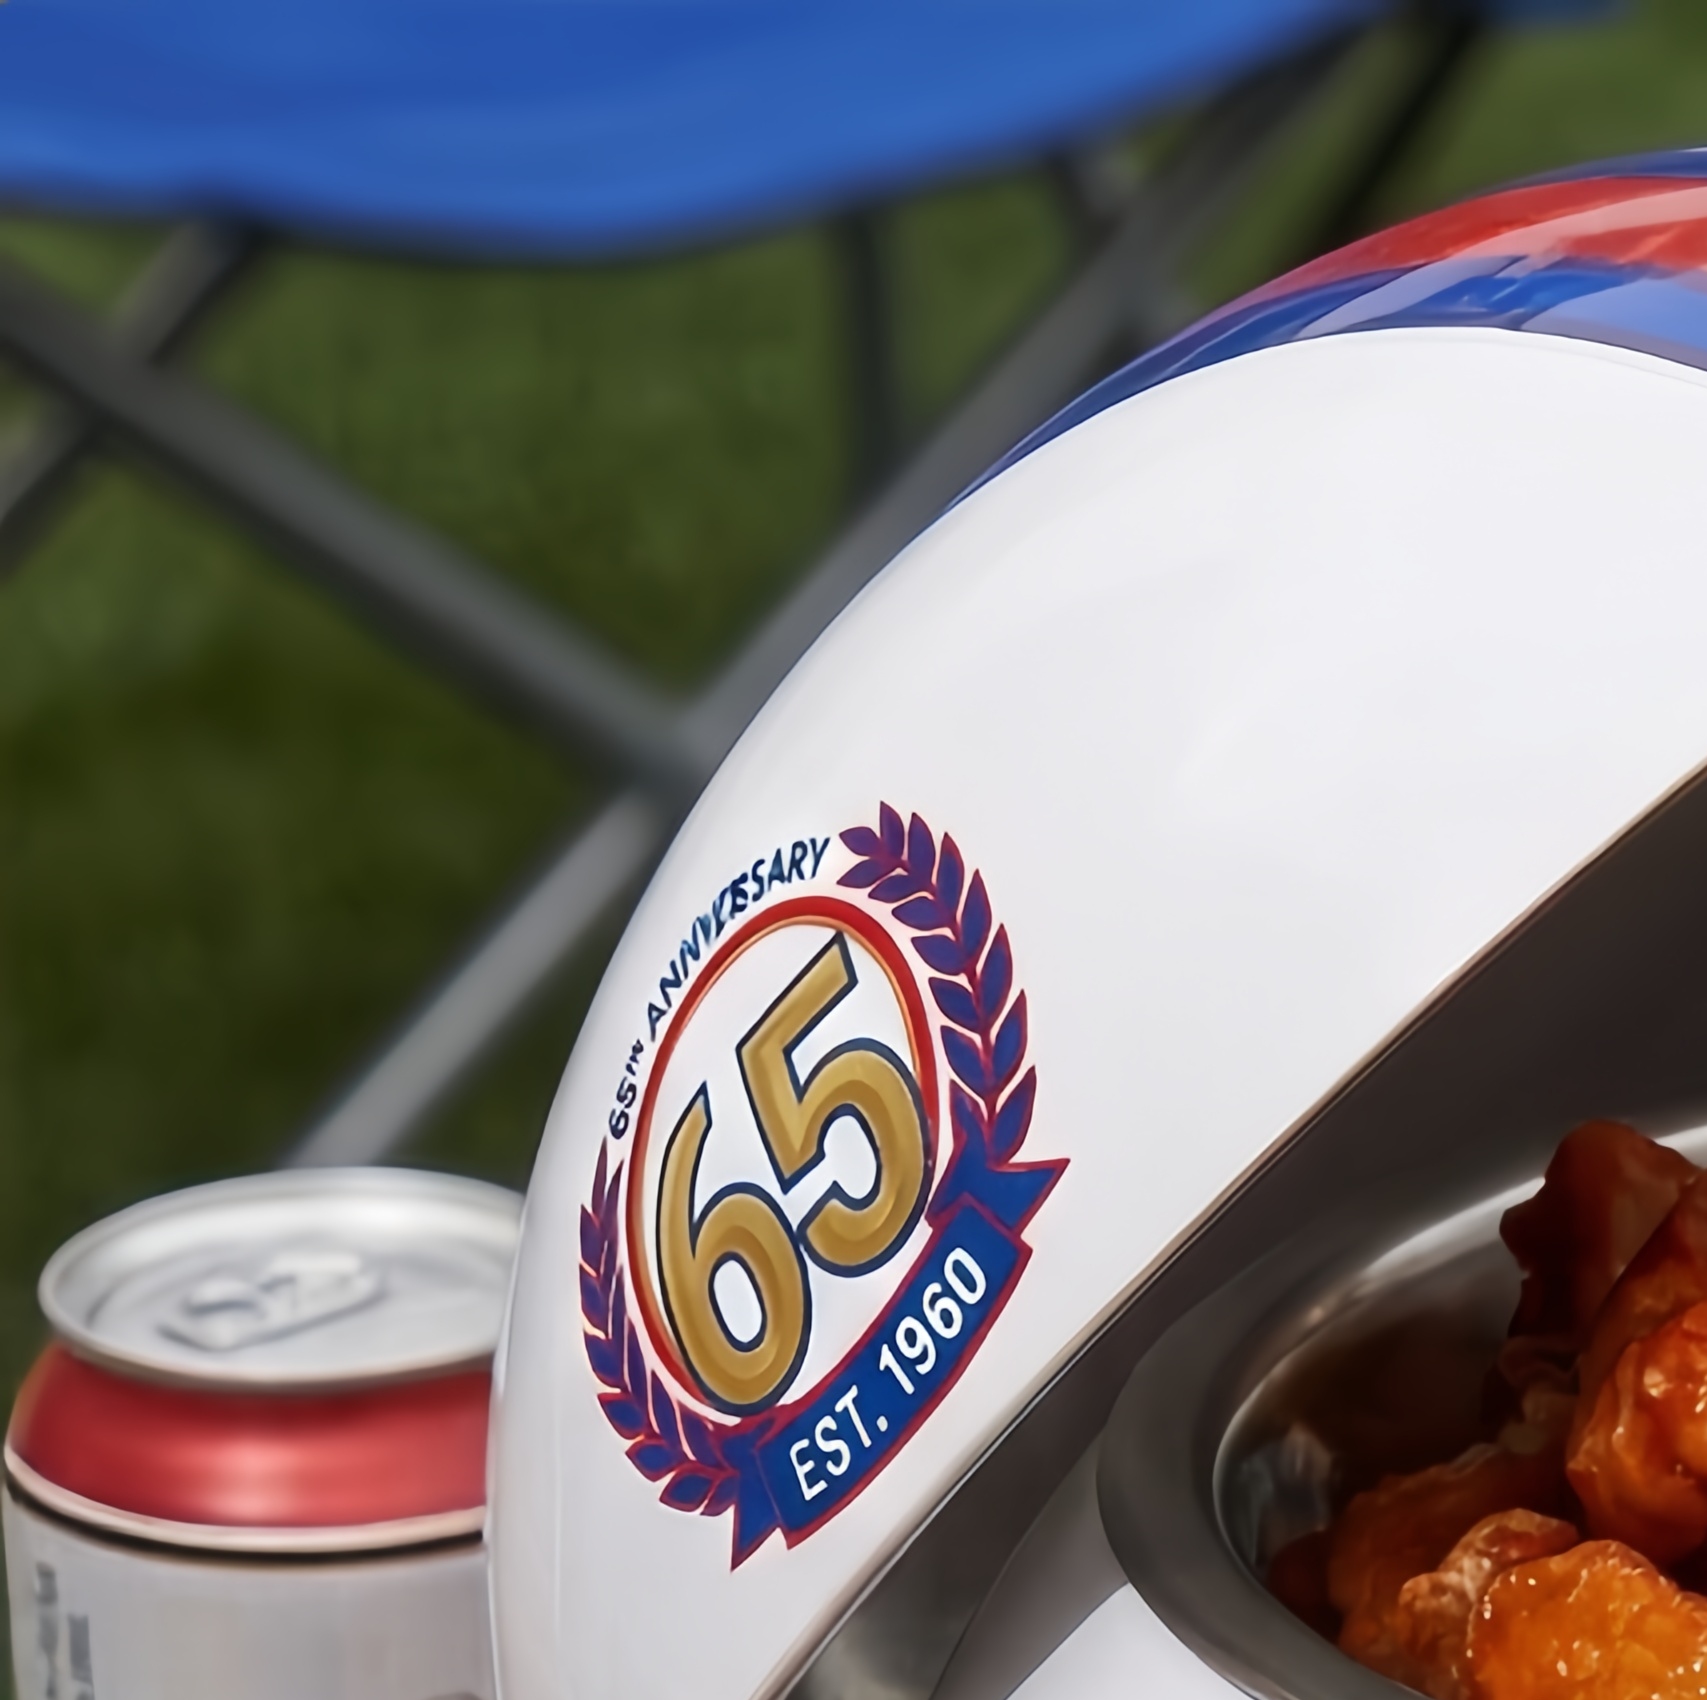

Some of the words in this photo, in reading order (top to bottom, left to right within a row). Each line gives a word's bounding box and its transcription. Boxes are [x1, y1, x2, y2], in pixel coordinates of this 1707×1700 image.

[655, 930, 934, 1417] 65
[788, 1384, 889, 1503] EST.
[878, 1247, 988, 1386] 1960
